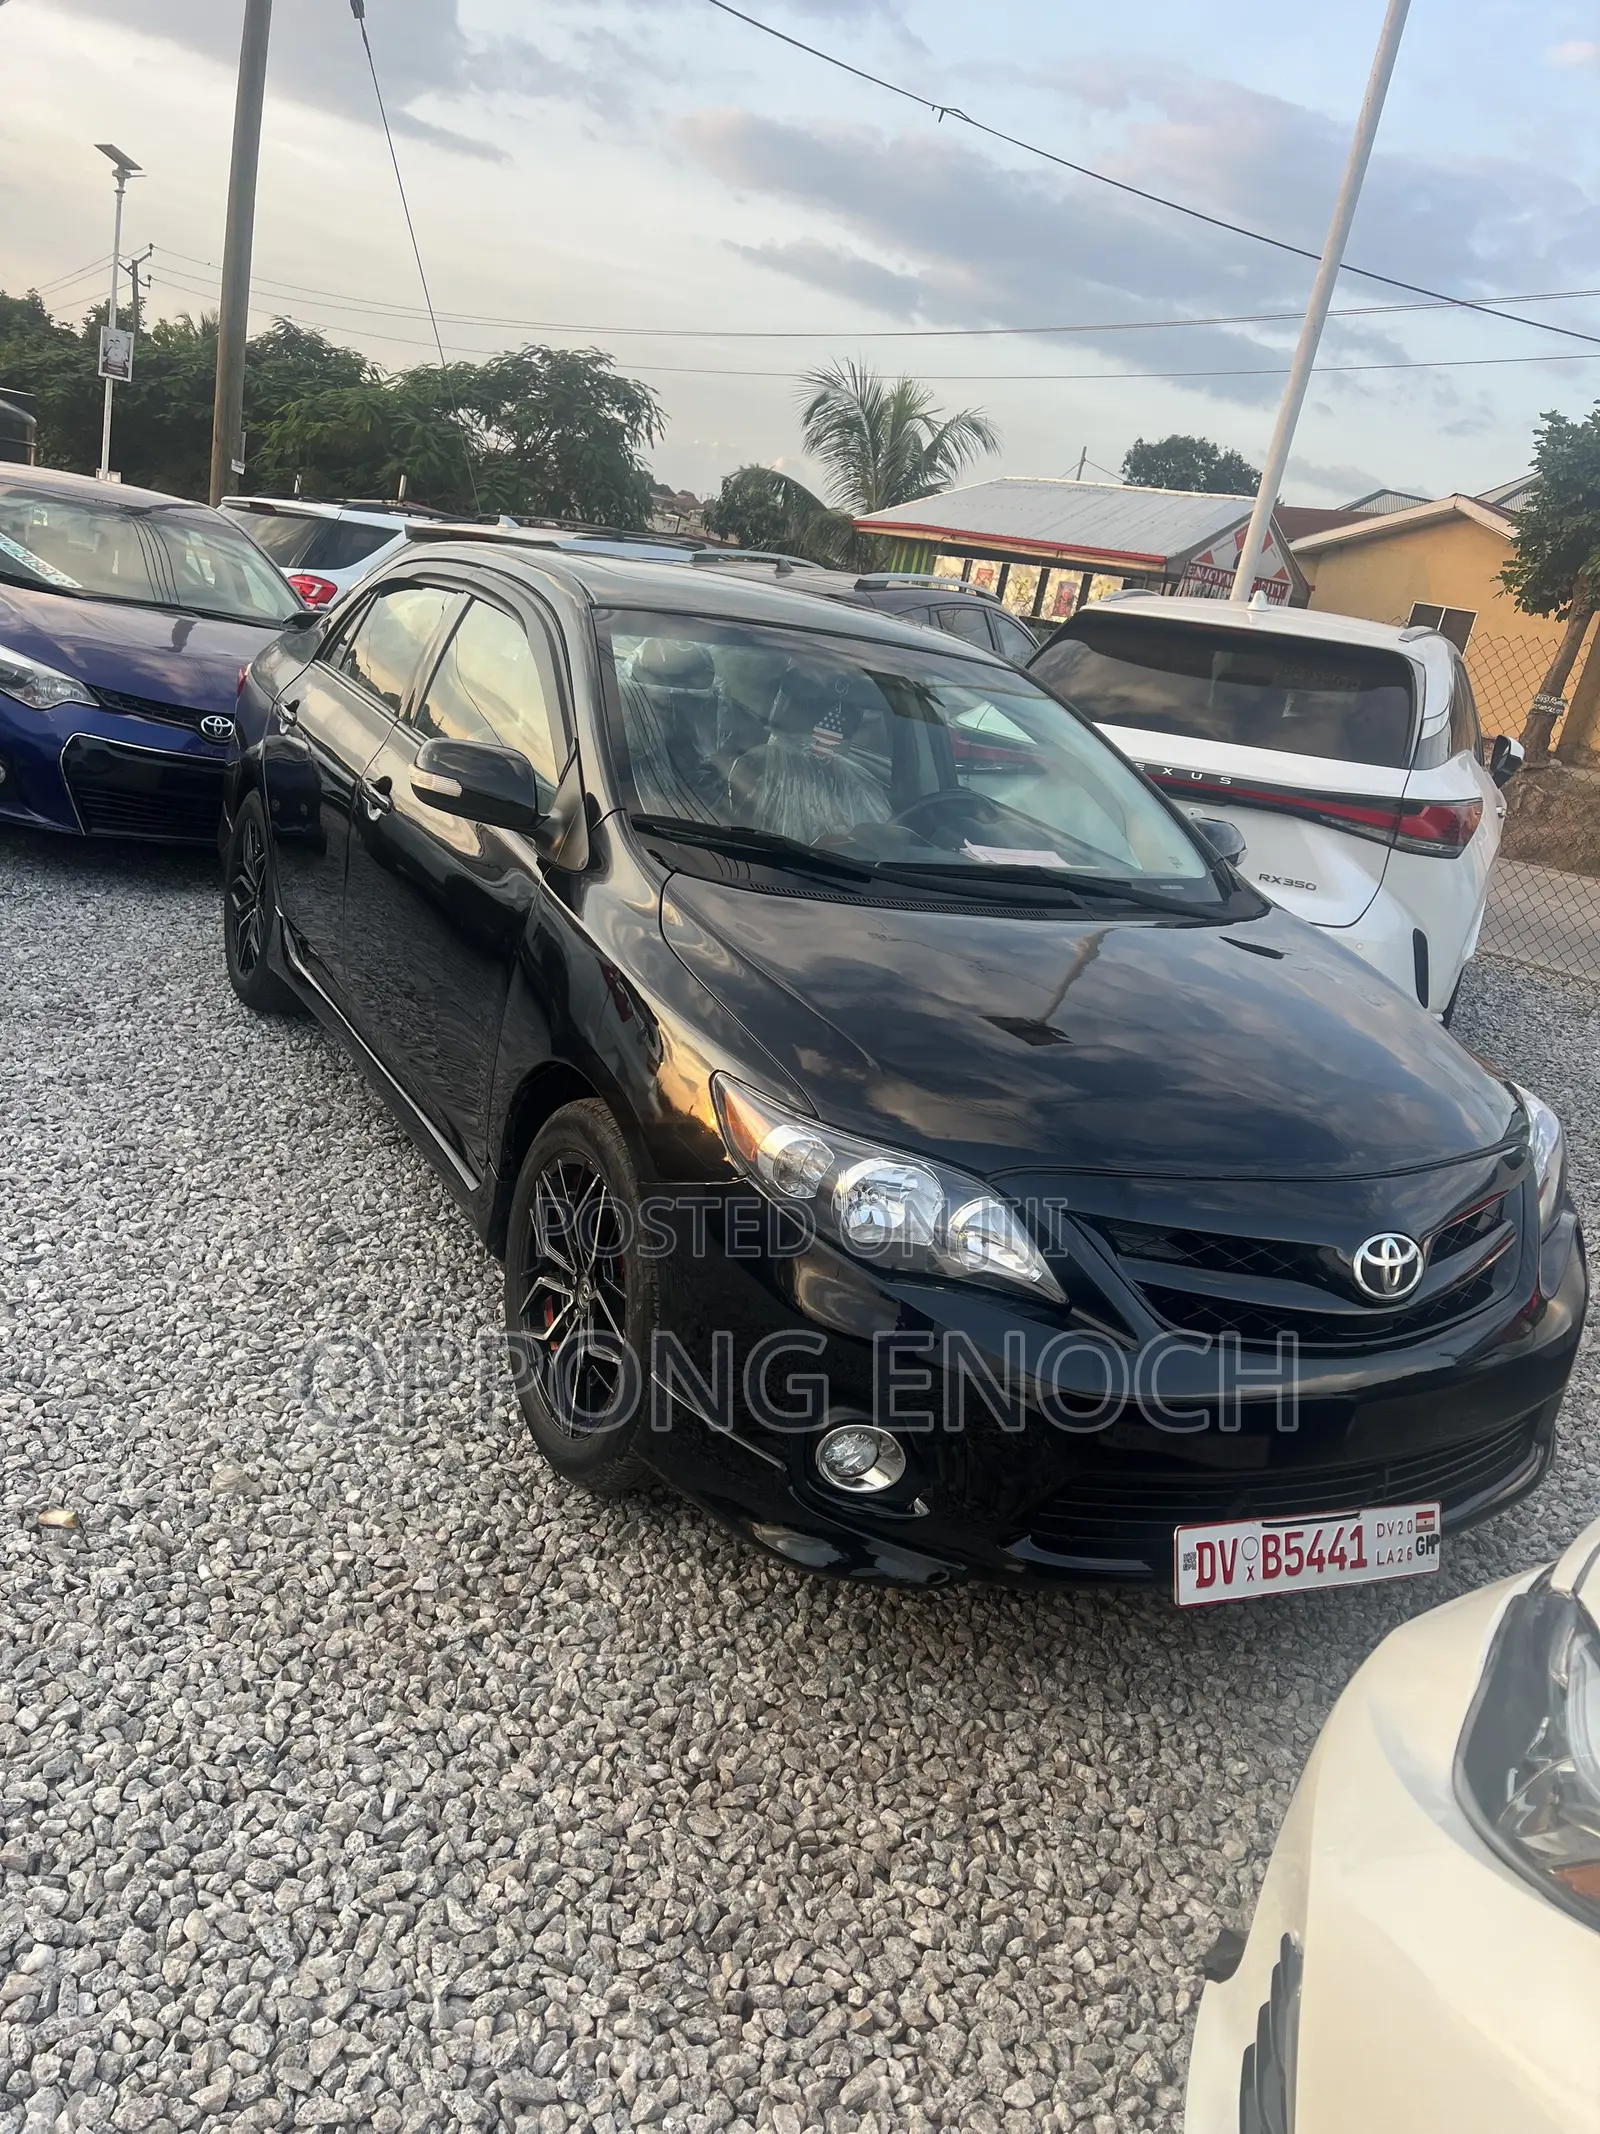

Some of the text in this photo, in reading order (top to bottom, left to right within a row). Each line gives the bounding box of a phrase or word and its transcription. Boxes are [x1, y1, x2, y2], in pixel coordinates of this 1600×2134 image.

[1187, 565, 1237, 588] ENJOYM
[1134, 762, 1232, 785] EXUS
[1259, 873, 1317, 891] RX350
[1376, 1519, 1413, 1538] DV20
[1195, 1538, 1238, 1588] DV
[1261, 1524, 1368, 1580] B5441
[1376, 1546, 1413, 1566] LA26
